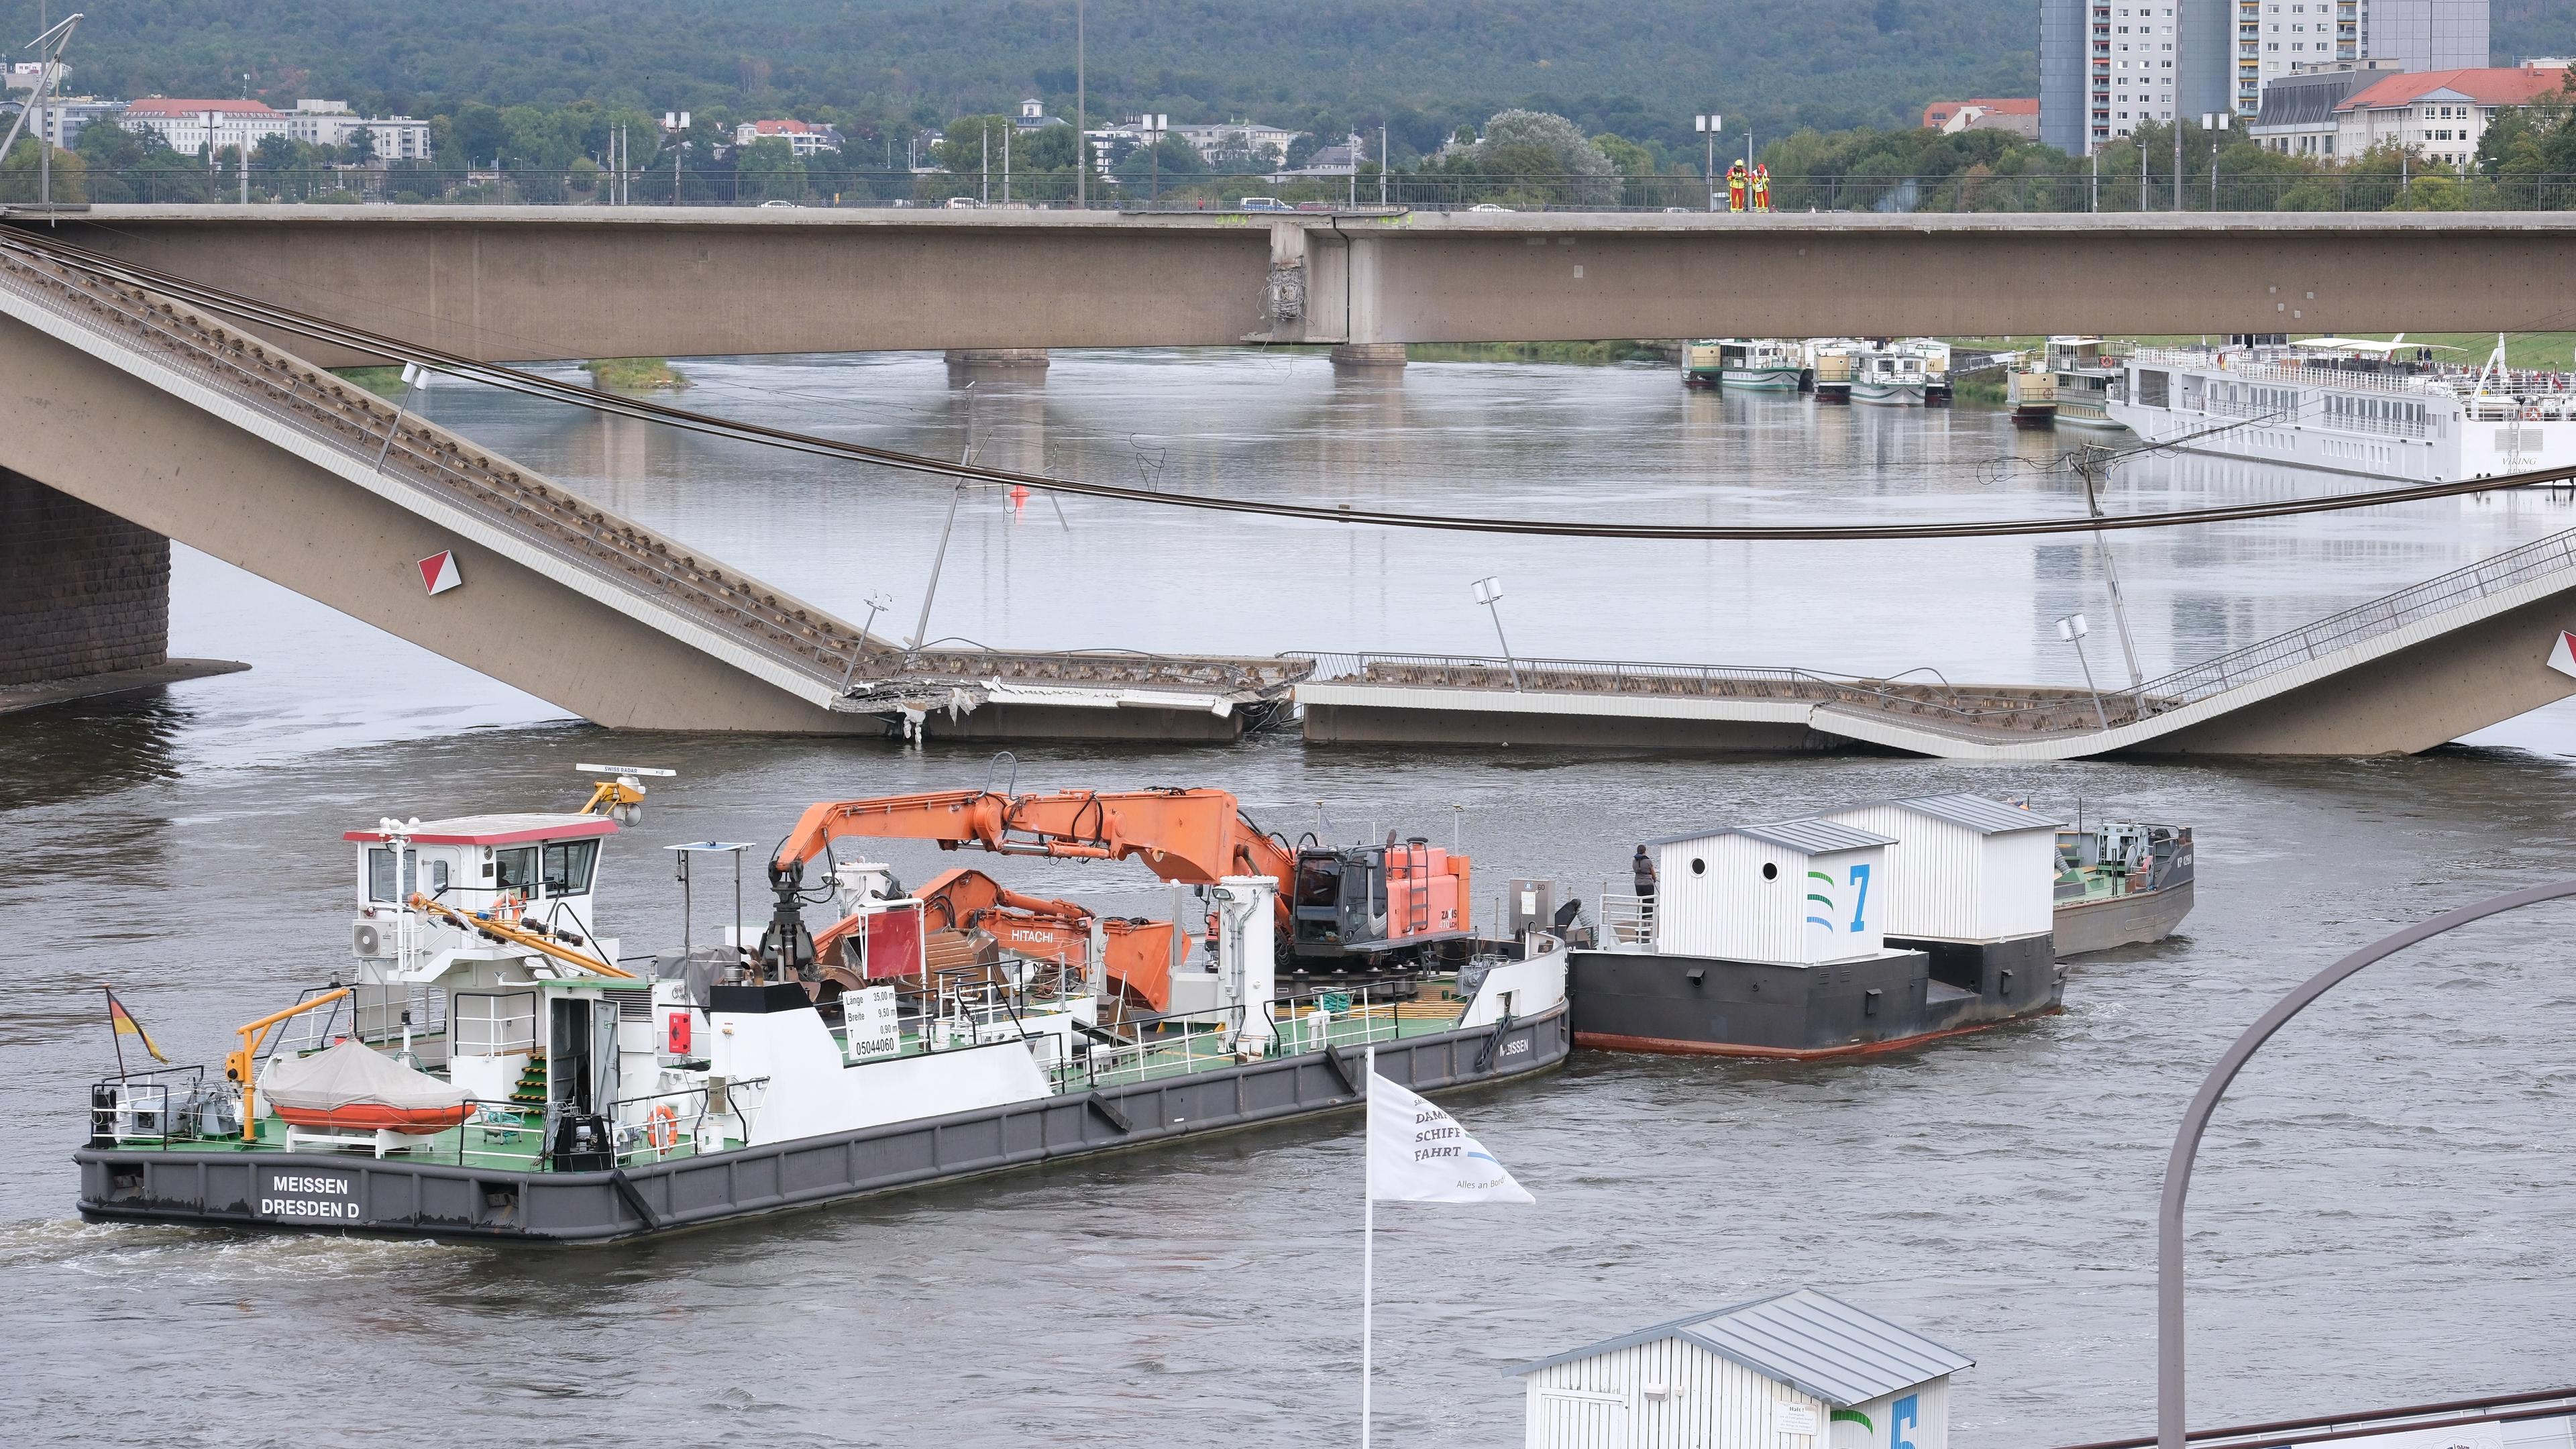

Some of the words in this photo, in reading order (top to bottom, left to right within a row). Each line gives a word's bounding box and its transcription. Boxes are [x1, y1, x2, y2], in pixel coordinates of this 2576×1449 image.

[1849, 864, 1870, 932] 7
[1441, 908, 1457, 920] ZAXIS
[1012, 930, 1053, 943] HITACHI
[846, 996, 863, 1007] Länge
[873, 991, 888, 1002] 35,00
[848, 1012, 865, 1022] Breite
[878, 1008, 890, 1018] 9,50
[850, 1030, 853, 1038] T
[880, 1025, 891, 1035] 0,90
[856, 1037, 894, 1055] 05044060
[1415, 1128, 1460, 1142] SCHIFF
[1414, 1146, 1461, 1162] FAHRT
[274, 1176, 347, 1195] MEISSEN
[1456, 1180, 1475, 1189] Alles
[262, 1199, 342, 1218] DRESDEN
[347, 1203, 360, 1218] D
